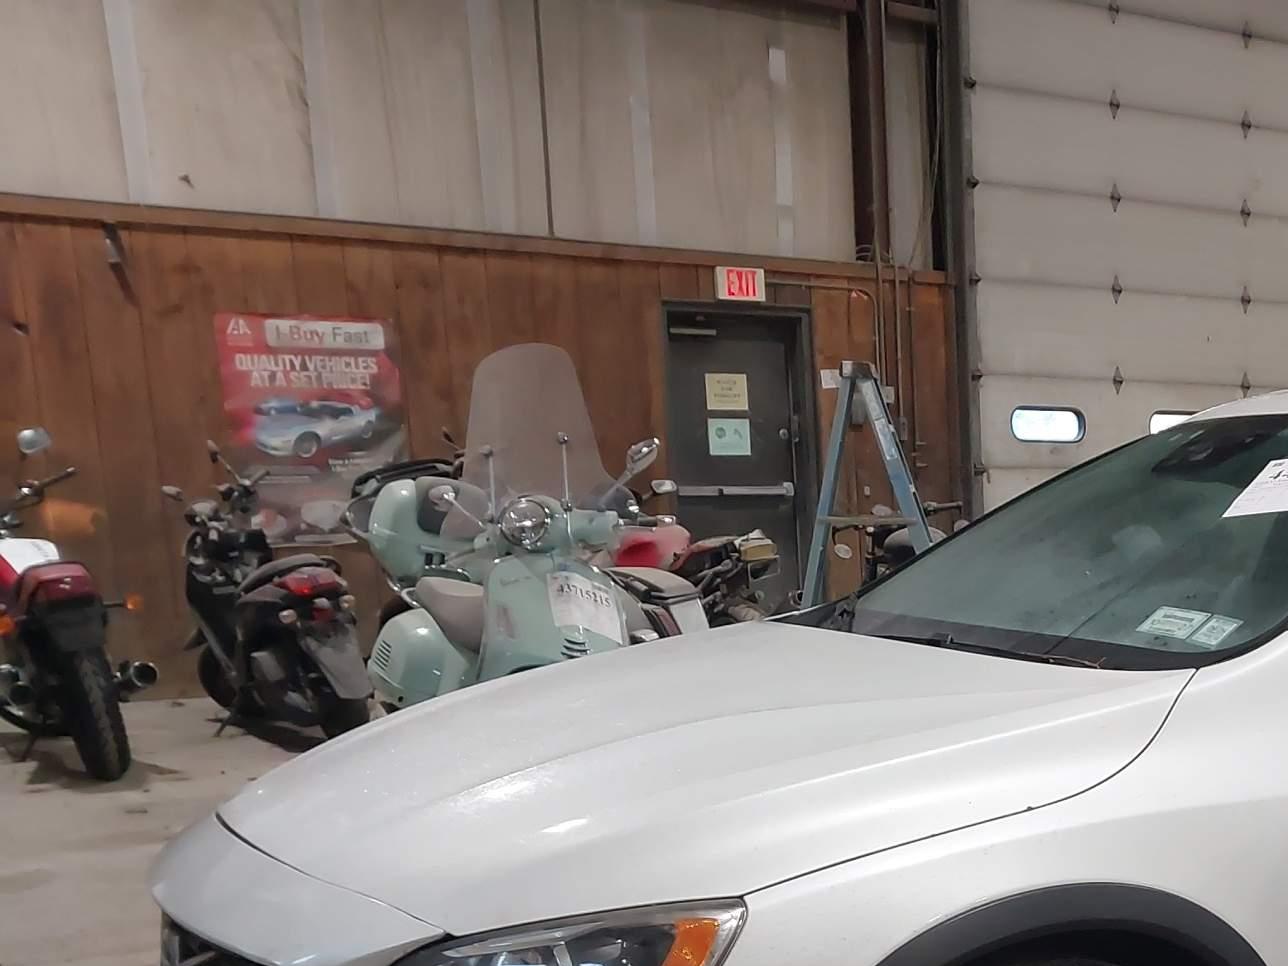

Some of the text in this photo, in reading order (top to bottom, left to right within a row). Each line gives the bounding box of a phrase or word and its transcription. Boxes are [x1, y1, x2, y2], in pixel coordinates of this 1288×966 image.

[726, 269, 757, 297] EXIT
[331, 326, 371, 344] Fast
[235, 353, 379, 374] QUALITY VEHICLES
[250, 371, 371, 390] AT A SET PRICE!
[556, 583, 612, 608] 43715215
